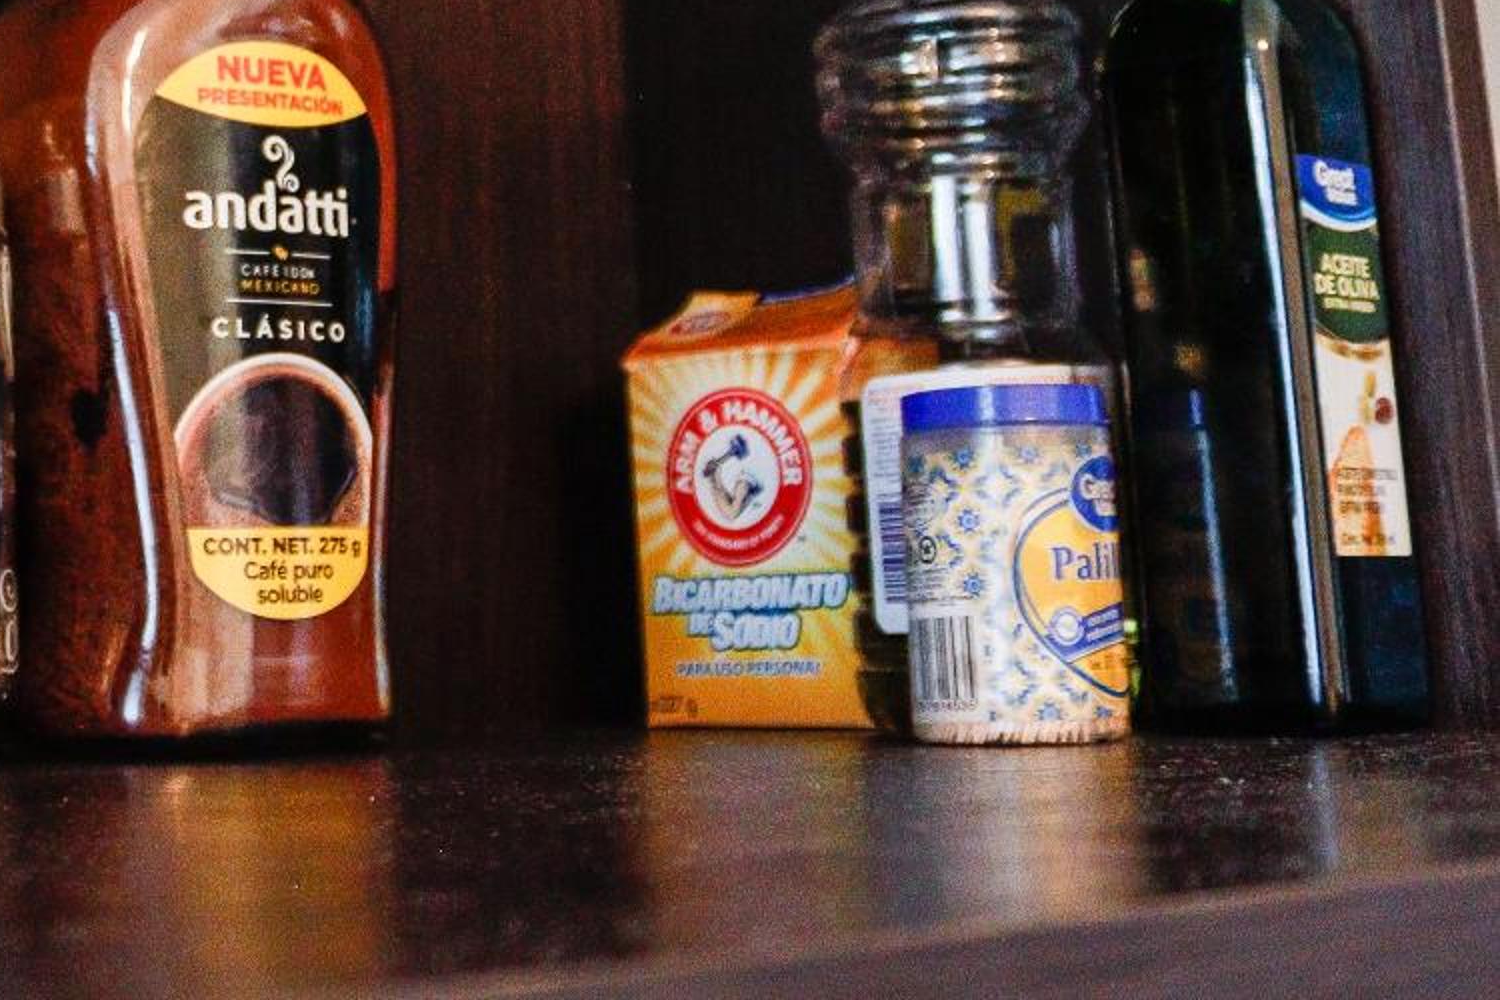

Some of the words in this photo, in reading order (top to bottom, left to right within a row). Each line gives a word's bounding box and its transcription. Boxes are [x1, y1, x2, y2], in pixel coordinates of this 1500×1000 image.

[217, 55, 327, 91] NUEVA
[197, 87, 344, 117] PRESENTACIÓN
[183, 179, 350, 238] andatti
[1320, 252, 1371, 279] ACEITE
[241, 279, 321, 295] MEXICANO
[1314, 272, 1337, 295] DE
[1337, 277, 1380, 300] OLIVA
[211, 315, 347, 342] CLÁSICO
[675, 430, 701, 493] ARM
[722, 400, 804, 486] HAMMER
[202, 537, 267, 555] CONT.
[273, 537, 314, 555] NET.
[319, 537, 349, 554] 275
[243, 560, 287, 580] Café
[293, 564, 335, 583] puro
[258, 584, 324, 604] soluble
[653, 573, 850, 614] BICARBONATO
